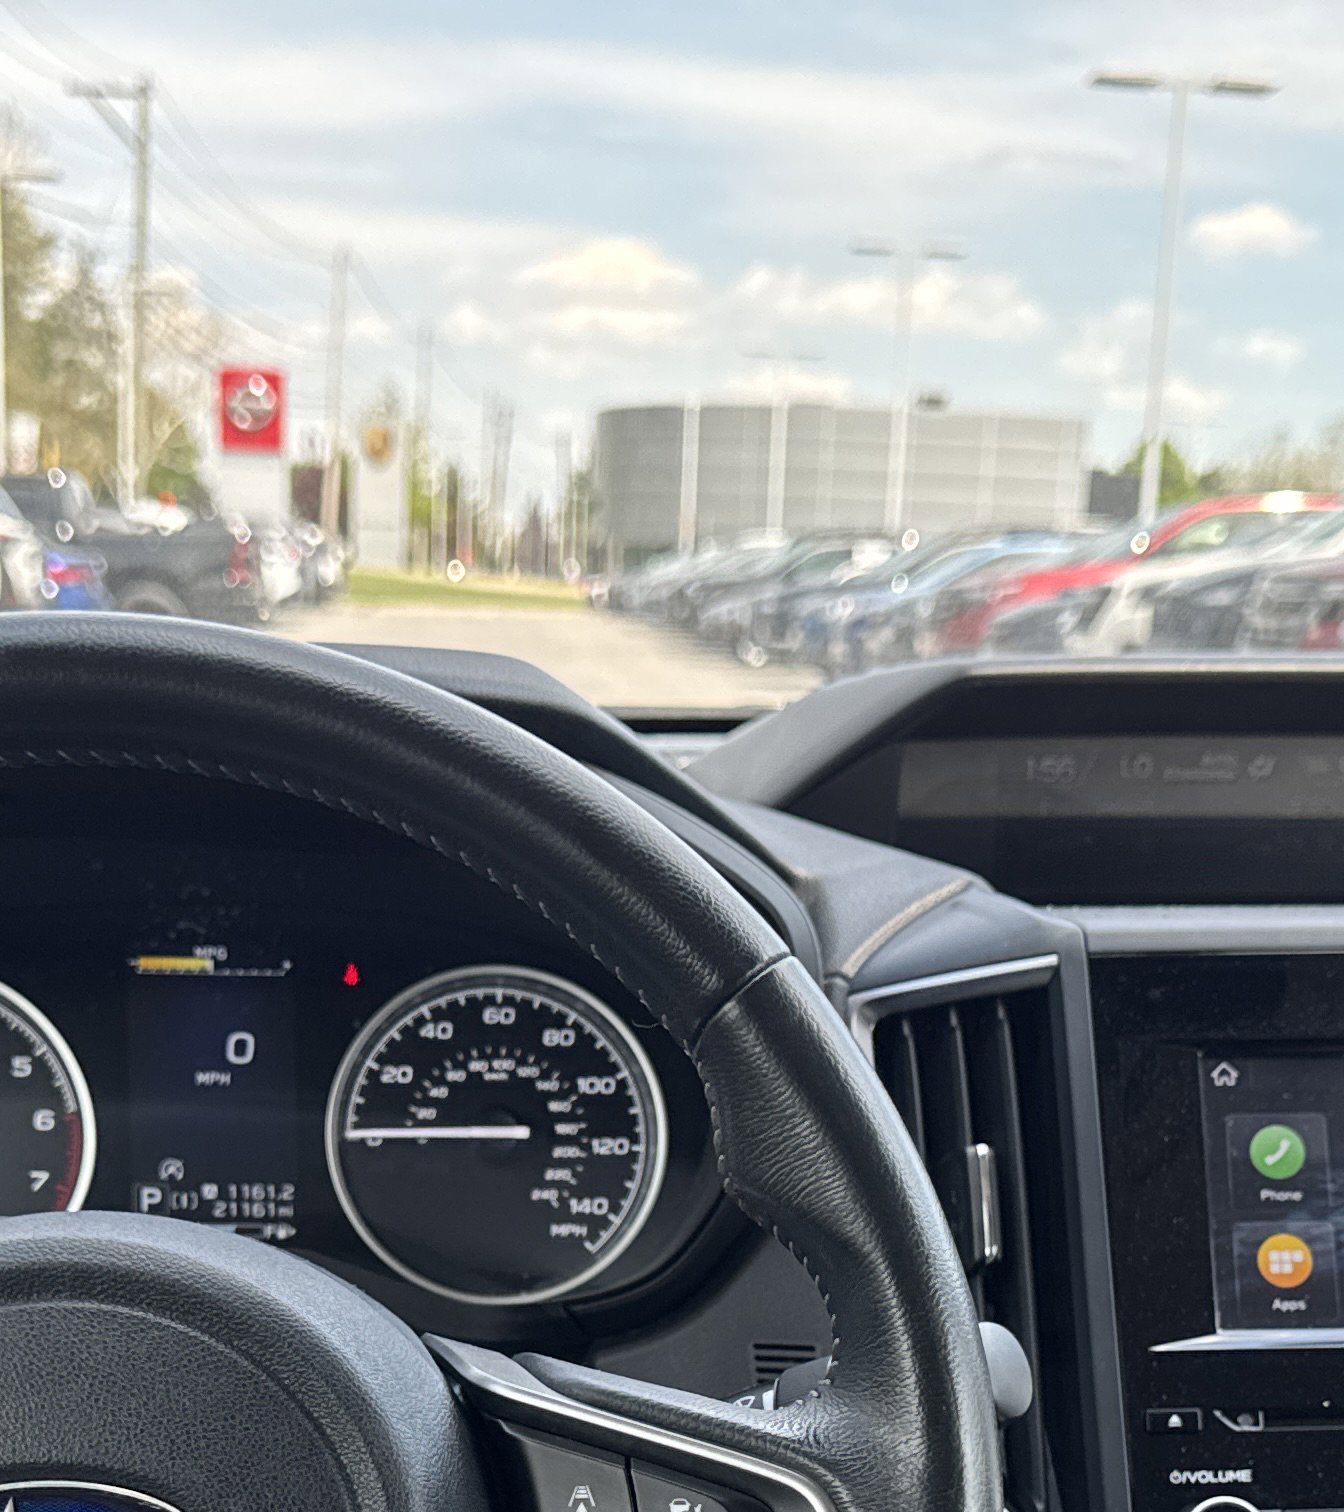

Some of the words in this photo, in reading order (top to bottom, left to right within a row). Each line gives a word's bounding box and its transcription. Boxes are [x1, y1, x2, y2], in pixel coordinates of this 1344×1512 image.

[482, 1006, 516, 1025] 60
[419, 1021, 453, 1040] 40
[542, 1028, 576, 1047] 80
[225, 1031, 255, 1065] 0
[10, 1056, 33, 1078] 5
[380, 1065, 413, 1084] 20
[194, 1071, 231, 1086] MPH
[577, 1077, 616, 1095] 100
[33, 1109, 55, 1131] 6
[591, 1138, 629, 1156] 120
[29, 1170, 51, 1192] 7
[139, 1186, 162, 1213] P
[1260, 1188, 1303, 1202] Phone
[569, 1197, 609, 1215] 140
[550, 1224, 587, 1237] MPH
[1272, 1298, 1306, 1312] Apps
